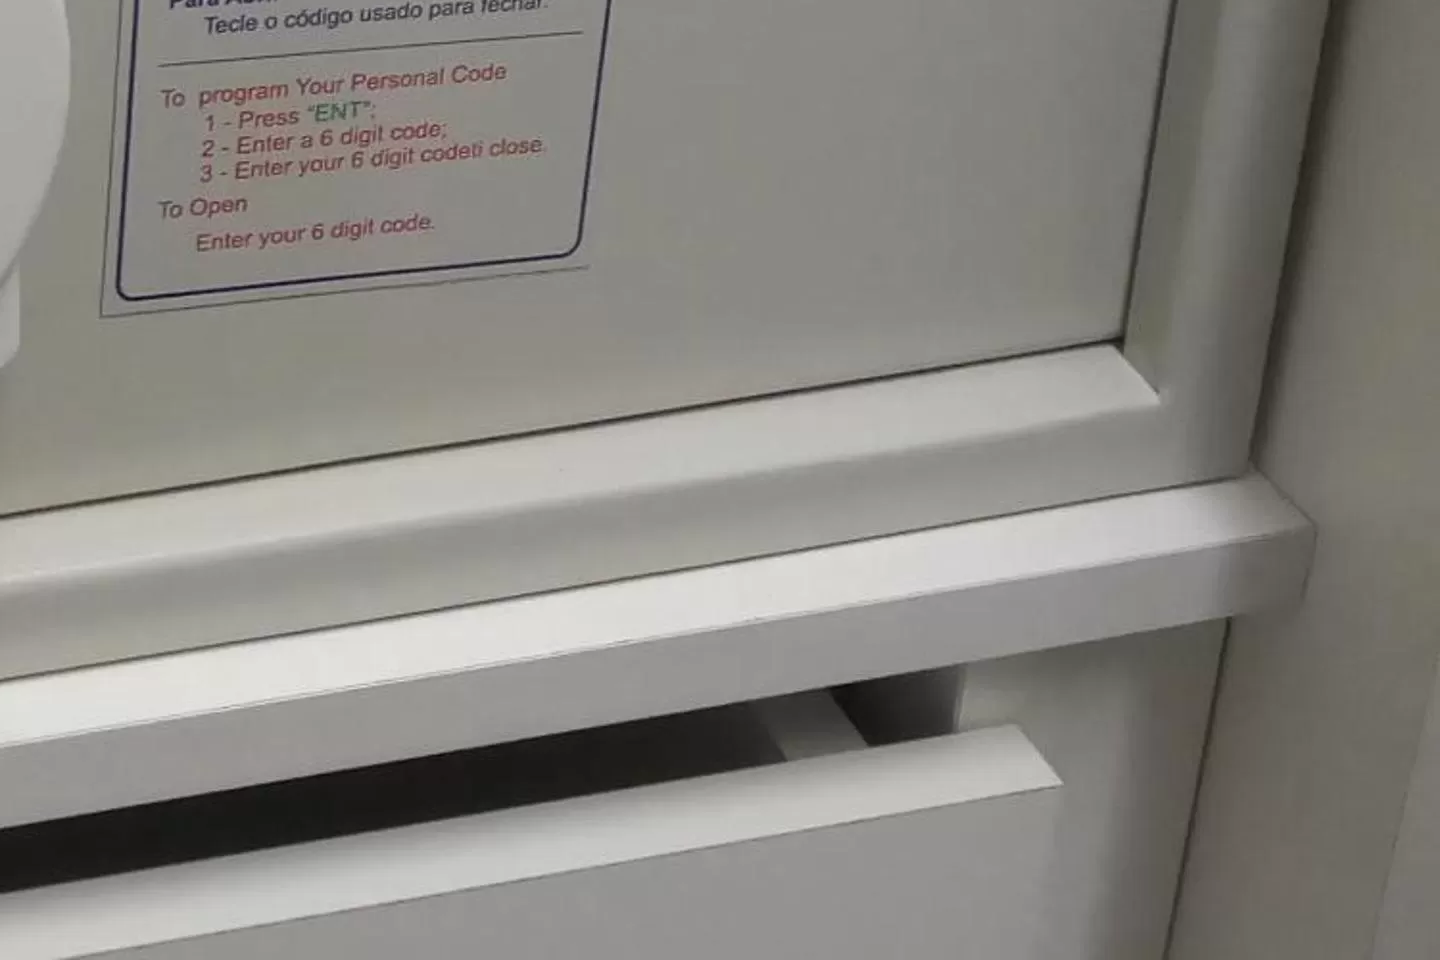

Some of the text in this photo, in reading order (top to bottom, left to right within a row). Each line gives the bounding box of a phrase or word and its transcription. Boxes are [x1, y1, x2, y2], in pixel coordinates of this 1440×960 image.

[205, 15, 258, 35] Tecle
[264, 16, 277, 30] o
[284, 8, 353, 29] código
[360, 2, 422, 22] usado
[429, 0, 474, 19] para
[160, 63, 507, 109] To program Your Personal Code
[205, 114, 214, 132] 1
[238, 110, 300, 129] Press
[202, 140, 214, 158] 2
[236, 134, 293, 154] Enter
[300, 135, 313, 149] a
[320, 129, 333, 147] 6
[341, 124, 383, 147] digit
[199, 165, 212, 183] 3
[235, 160, 293, 180] Enter
[298, 156, 344, 177] your
[351, 151, 364, 169] 6
[371, 148, 414, 170] digit
[158, 197, 248, 219] To Open
[196, 213, 434, 253] Enter your 6 digit code.
